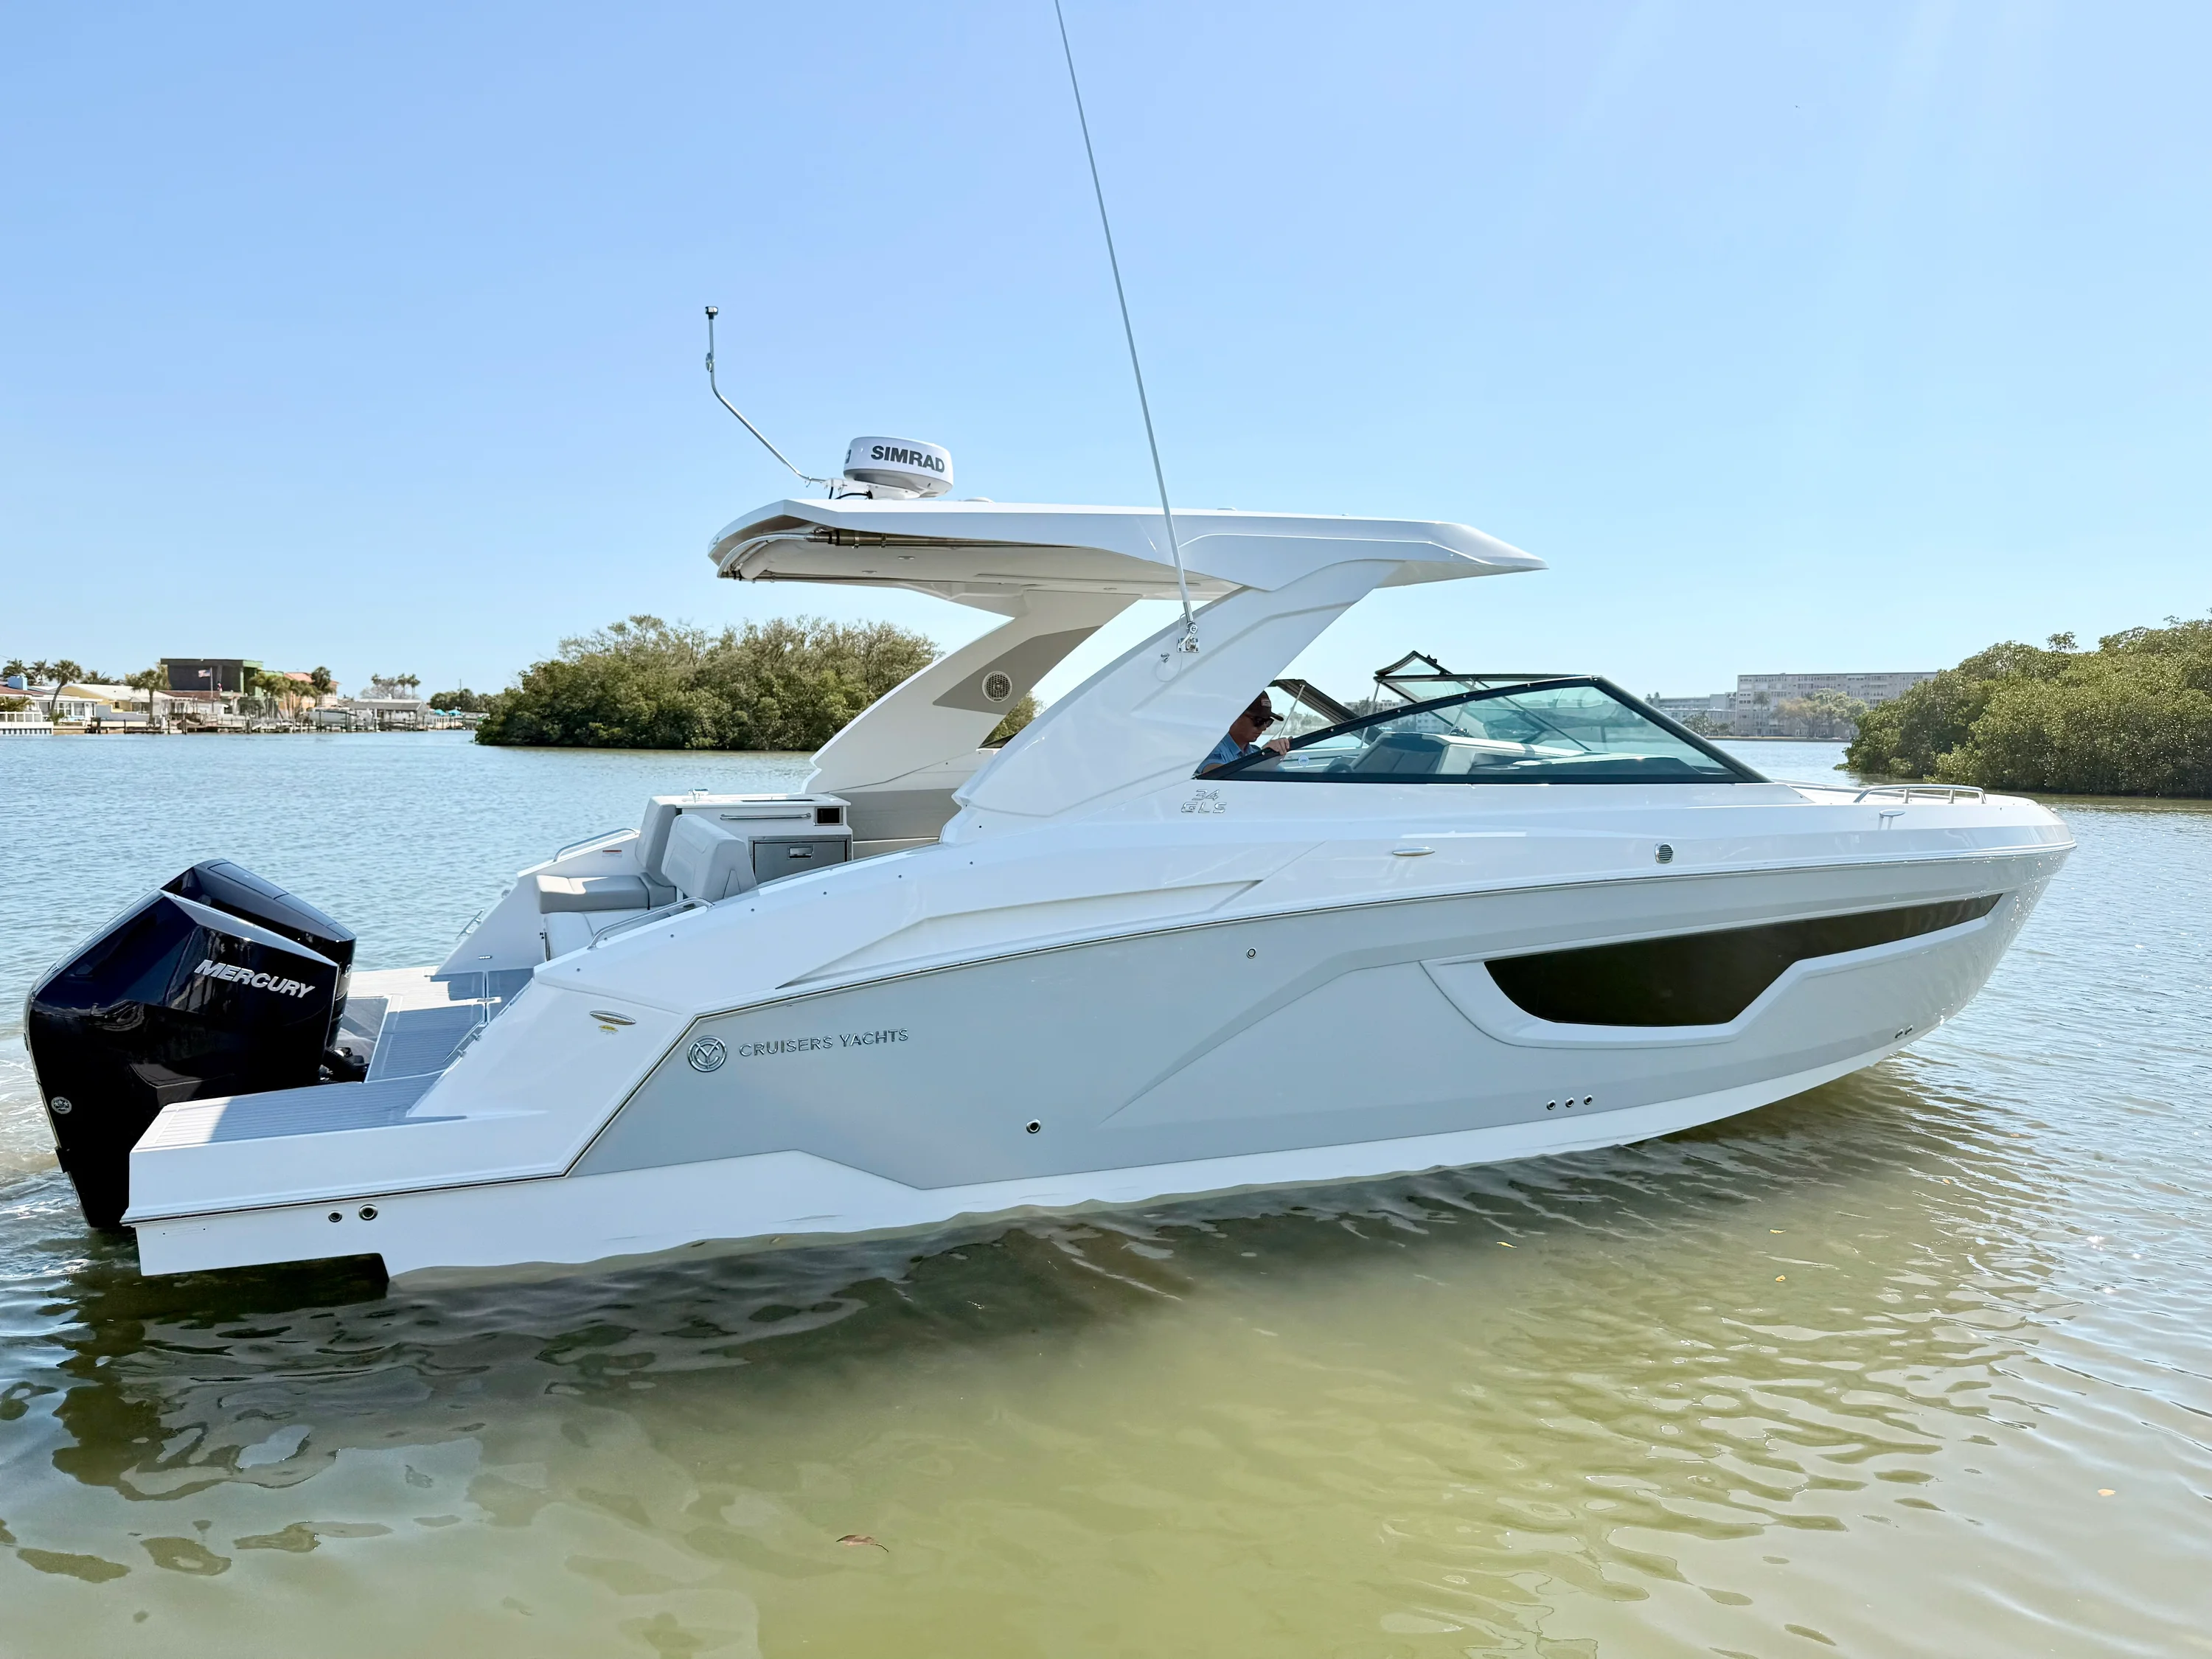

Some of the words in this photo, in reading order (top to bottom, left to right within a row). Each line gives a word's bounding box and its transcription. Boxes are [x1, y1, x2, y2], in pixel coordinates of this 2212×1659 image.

[871, 445, 945, 473] SIMRAD
[1180, 801, 1228, 814] GLS
[1192, 788, 1220, 801] 34
[194, 959, 316, 998] MERCURY
[739, 1035, 833, 1057] CRUISERS
[839, 1029, 909, 1047] YACHTS
